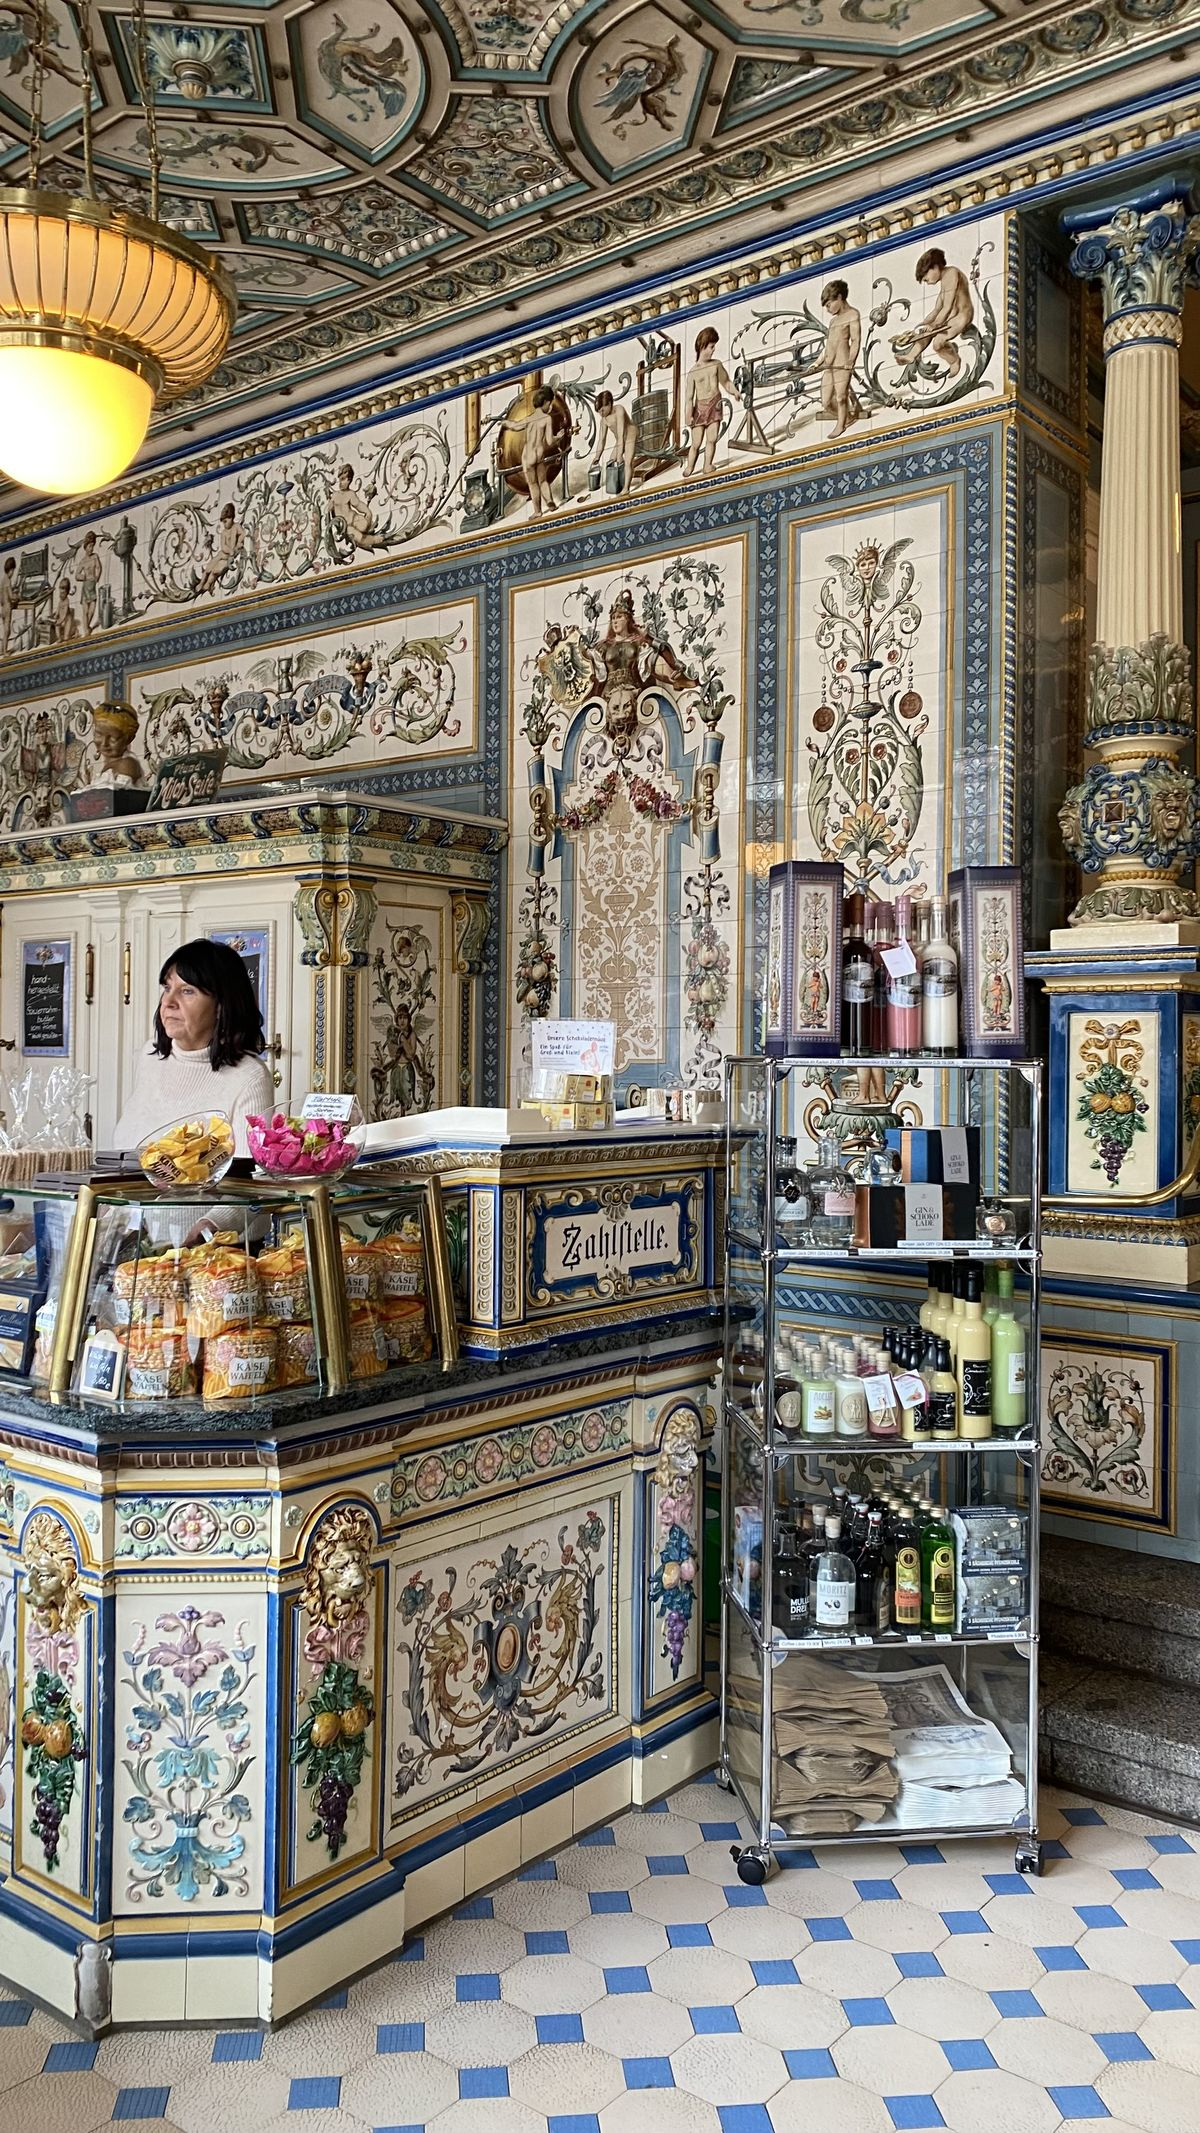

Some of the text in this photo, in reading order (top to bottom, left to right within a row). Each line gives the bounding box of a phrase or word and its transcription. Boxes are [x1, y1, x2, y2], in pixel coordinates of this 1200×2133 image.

[915, 1219, 934, 1227] LADE
[344, 1276, 364, 1286] ÄSE
[389, 1275, 414, 1285] KÄSE
[345, 1286, 367, 1294] FFELN
[384, 1283, 416, 1292] WAFFELN
[231, 1295, 257, 1306] KÄSE
[266, 1300, 287, 1309] ÄSE
[237, 1361, 265, 1371] KÄSE
[136, 1373, 163, 1384] KÄSE
[231, 1371, 267, 1380] WAFFELN
[820, 1583, 847, 1594] MORITZ
